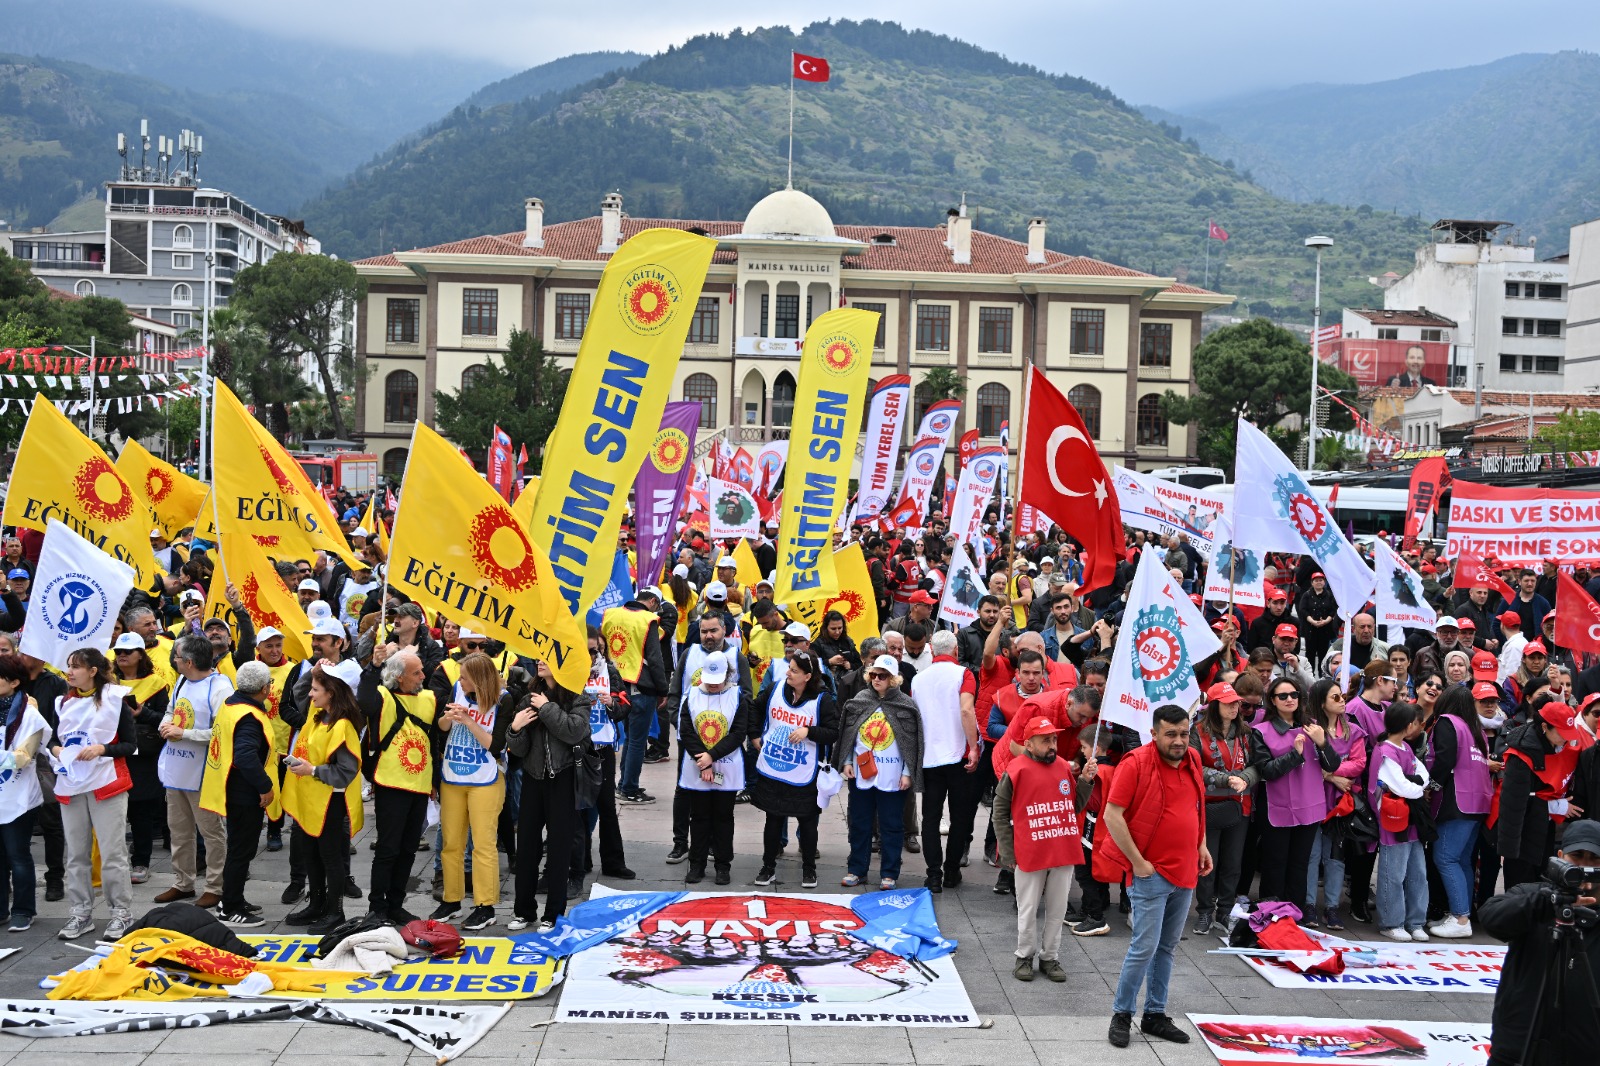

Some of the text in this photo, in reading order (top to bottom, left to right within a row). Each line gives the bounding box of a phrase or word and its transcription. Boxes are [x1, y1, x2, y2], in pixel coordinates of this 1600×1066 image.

[748, 262, 784, 272] MANİSA
[584, 349, 650, 464] SEN
[808, 389, 849, 463] SEN
[870, 391, 901, 491] TÜM YEREL-SEN
[1481, 453, 1543, 475] ROBUST COFFEE SHOP
[1156, 486, 1192, 503] YAŞASIN
[1200, 498, 1224, 510] MAYIS
[1144, 506, 1179, 525] EMEK EN
[1451, 504, 1504, 524] BASKI
[1510, 505, 1543, 523] VE
[787, 472, 837, 592] EĞİTİM
[1159, 523, 1177, 537] TÜM
[1447, 535, 1552, 557] DÜZENİNE
[65, 572, 92, 582] HİZMET
[1208, 586, 1261, 600] BİRLEŞİ METAL-İŞ
[403, 555, 573, 671] EĞİTİM SEN
[1385, 612, 1411, 622] BİRLEŞİK
[1140, 643, 1168, 666] DİSK
[467, 709, 495, 727] EVLİ
[771, 705, 814, 727] GÖREVLİ
[177, 749, 196, 760] SEN
[444, 743, 490, 766] KESK
[762, 740, 810, 766] KESK
[455, 765, 470, 774] 1995
[1026, 797, 1075, 817] BİRLEŞİK
[1028, 815, 1062, 829] METAL
[1031, 825, 1080, 842] SENDİKASI
[743, 899, 769, 920] 1
[656, 918, 866, 940] MAYIS
[346, 971, 539, 994] ŞUBESİ
[1300, 973, 1473, 988] MANİSA
[711, 992, 820, 1003] KESK
[567, 1008, 970, 1024] MANİSA ŞUBELER PLATFORMU
